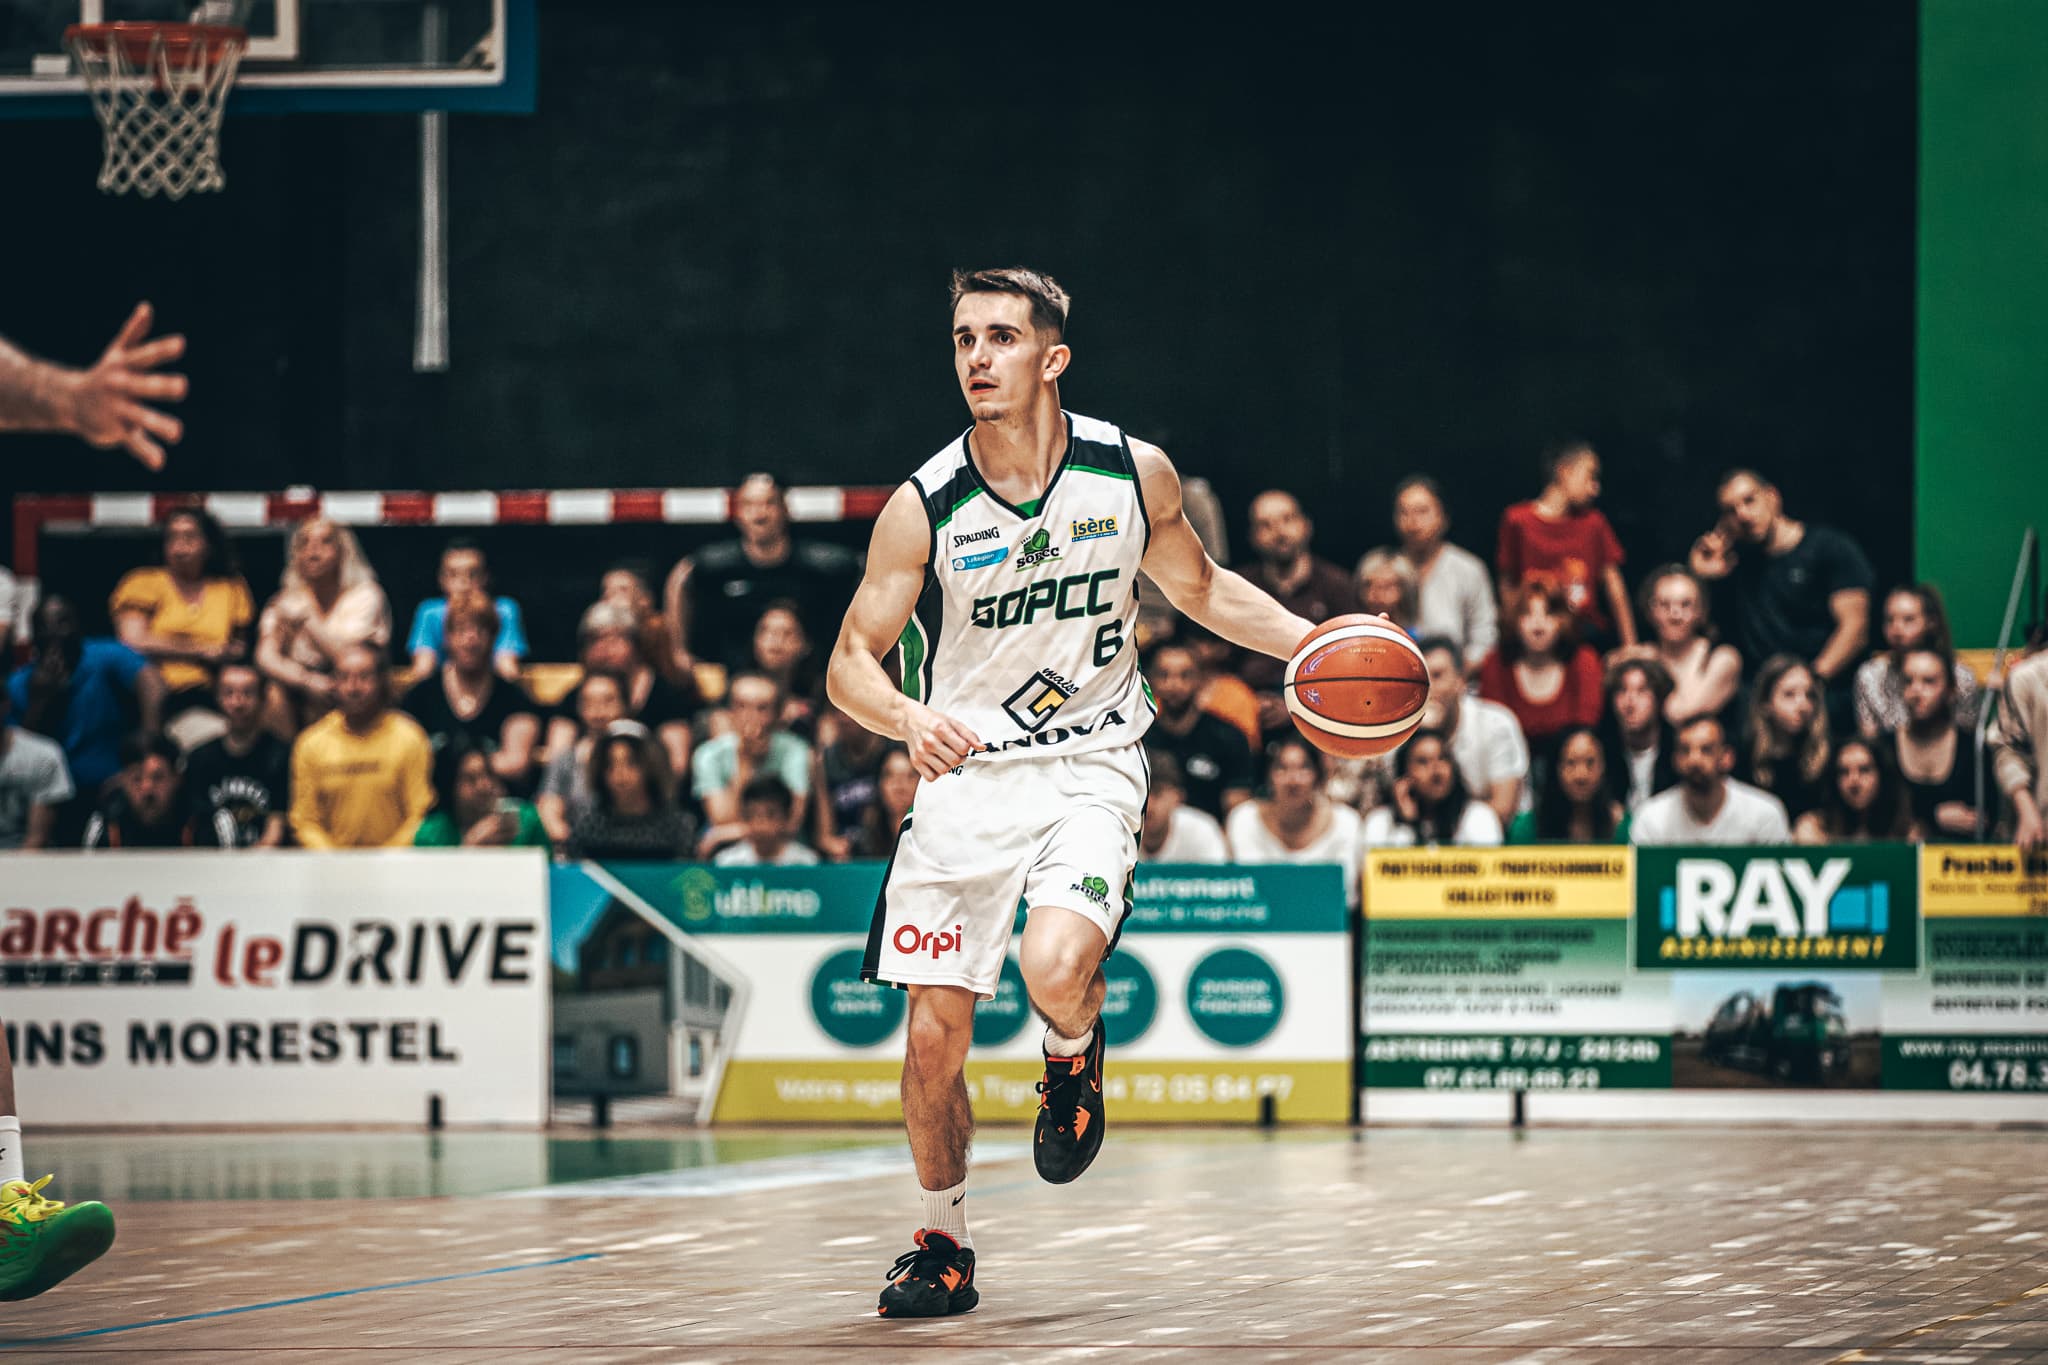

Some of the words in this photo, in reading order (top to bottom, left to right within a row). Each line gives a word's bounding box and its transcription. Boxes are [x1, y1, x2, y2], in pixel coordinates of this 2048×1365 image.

[954, 526, 1000, 548] SPALDING
[1073, 517, 1115, 536] isère
[971, 568, 1120, 629] SOPCC
[1093, 619, 1124, 668] 6
[1676, 858, 1852, 937] RAY
[893, 924, 962, 960] Orpi
[1659, 936, 1885, 959] ASSAINISSEMENT
[128, 1021, 458, 1064] MORESTEL
